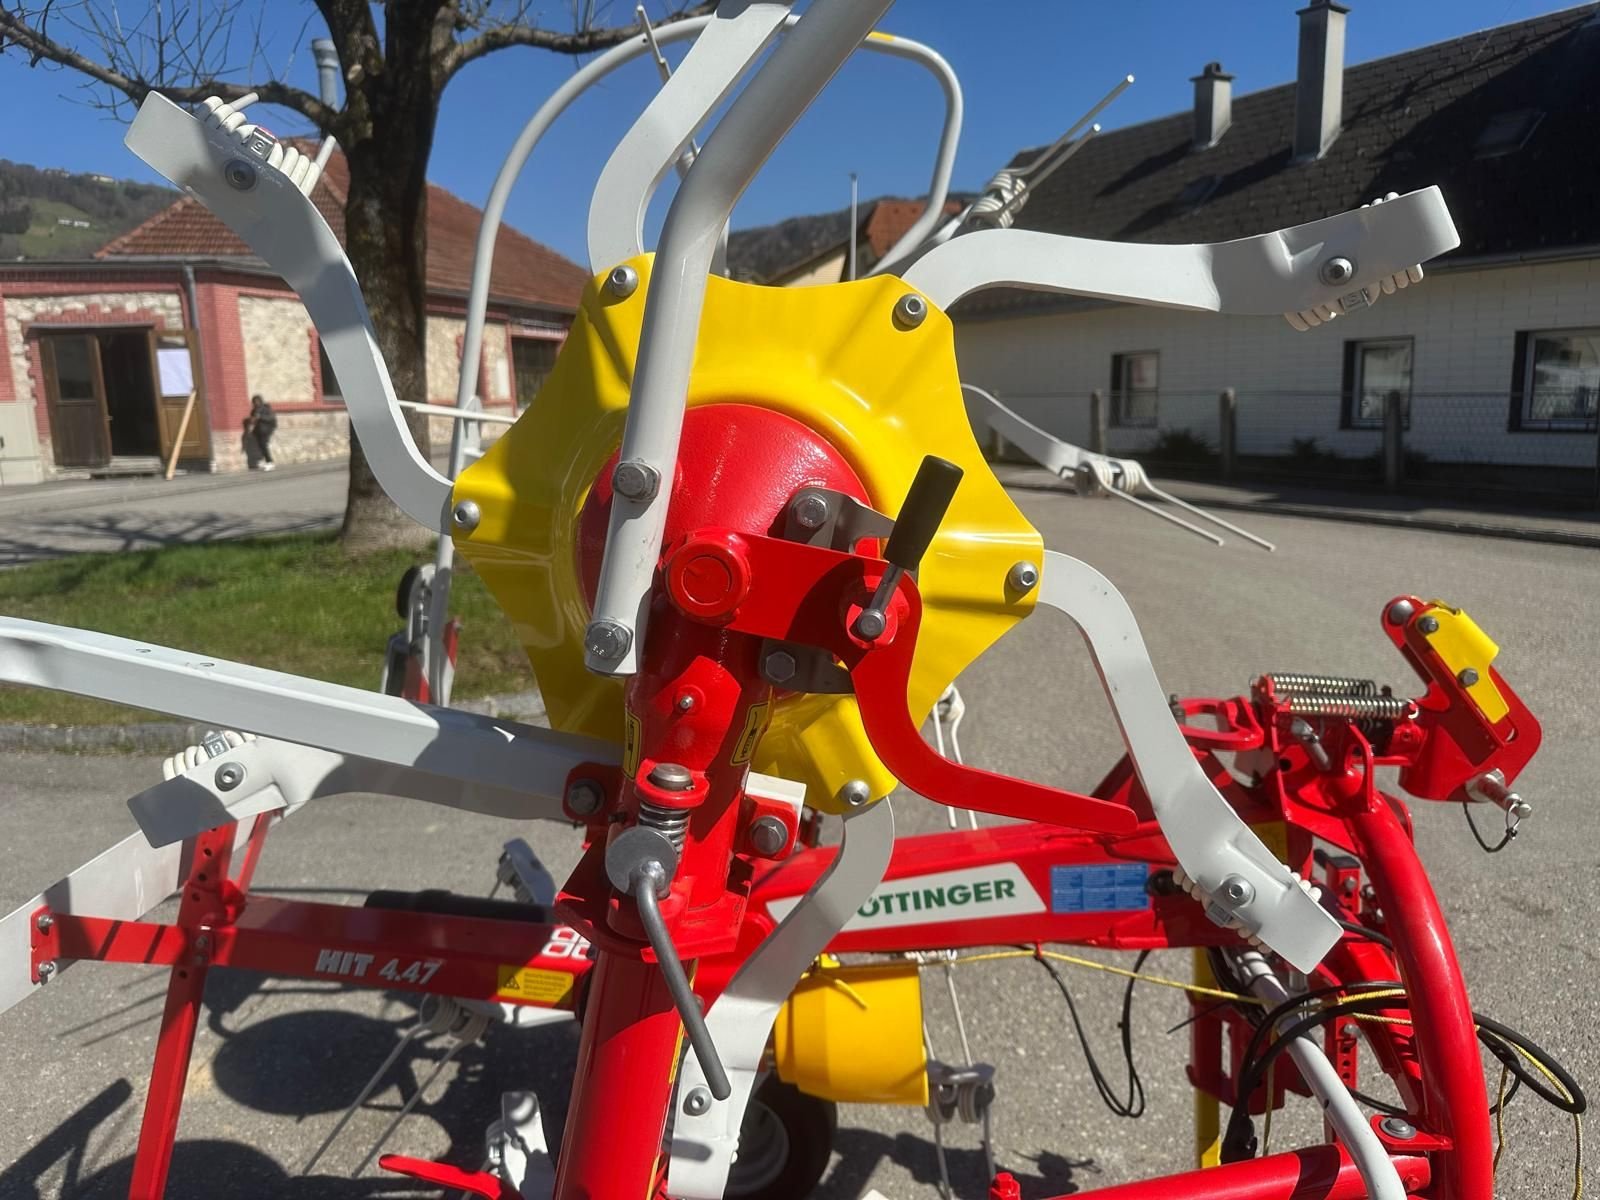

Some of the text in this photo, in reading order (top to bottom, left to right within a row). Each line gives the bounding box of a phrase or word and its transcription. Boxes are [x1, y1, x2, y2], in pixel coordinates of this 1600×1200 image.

[857, 879, 1016, 917] ÖTTINGER
[315, 949, 442, 985] HIT 4.47
